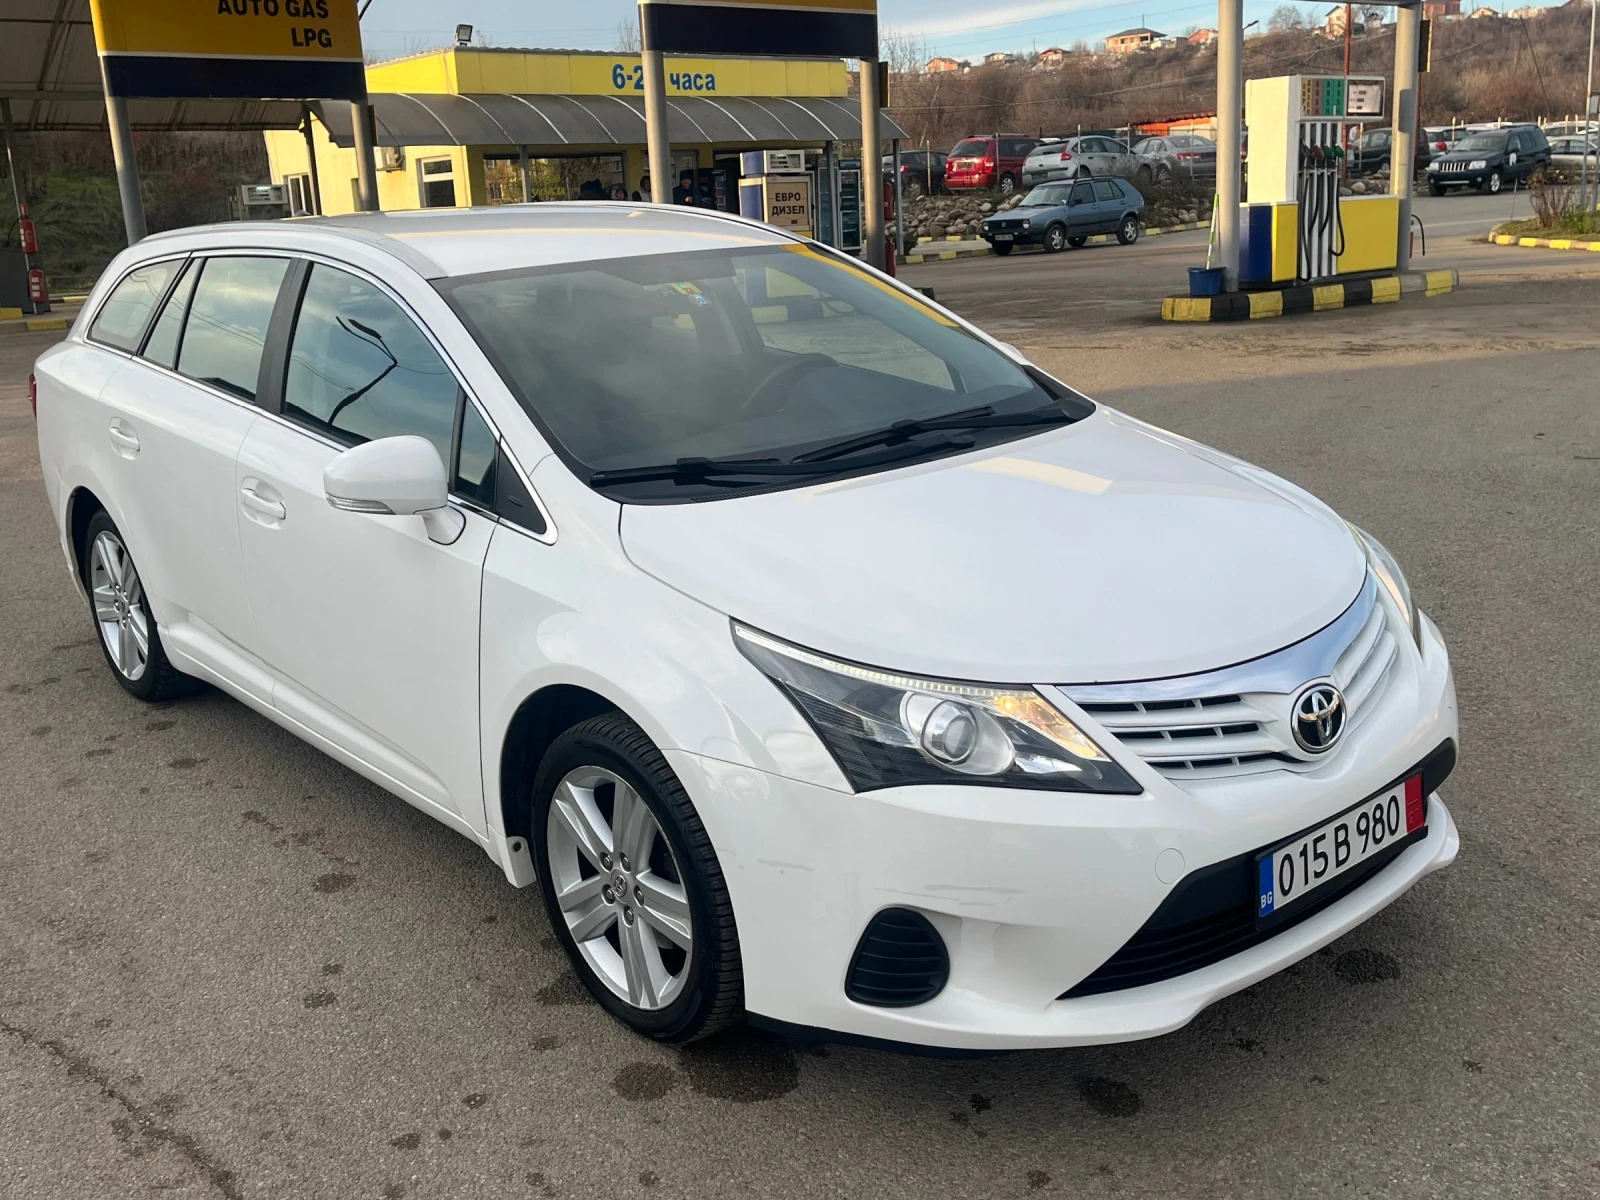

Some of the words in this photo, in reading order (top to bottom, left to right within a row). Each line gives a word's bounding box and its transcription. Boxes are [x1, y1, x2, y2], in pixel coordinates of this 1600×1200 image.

[218, 0, 279, 17] AUTO
[285, 0, 329, 19] GAS
[291, 27, 332, 48] LPG
[612, 64, 645, 90] 6-2
[670, 72, 716, 91] часа
[775, 192, 801, 202] ЕВРО
[771, 205, 805, 217] ДИЗЕЛ
[1261, 892, 1273, 908] BG
